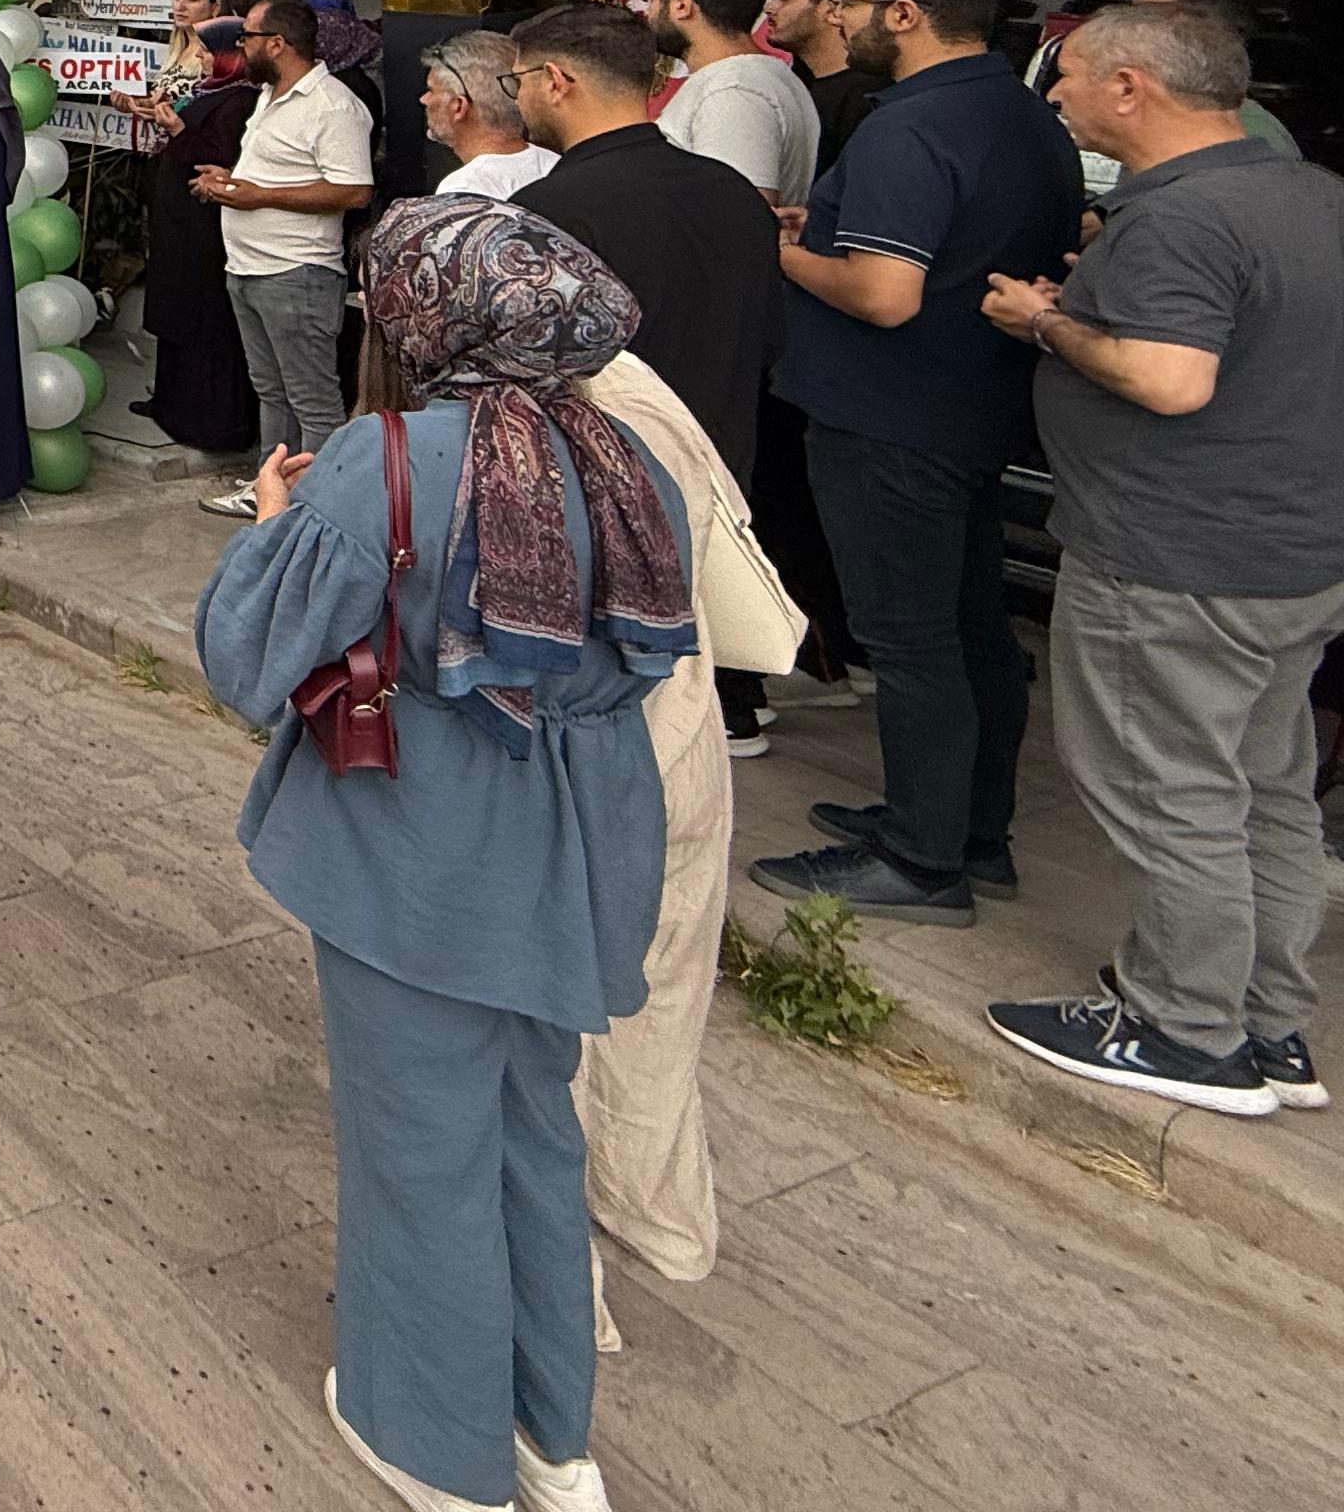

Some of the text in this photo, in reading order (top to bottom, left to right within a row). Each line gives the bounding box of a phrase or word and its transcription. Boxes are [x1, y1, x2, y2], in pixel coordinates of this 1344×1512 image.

[60, 55, 143, 81] OPTİK
[66, 80, 112, 91] ACAR
[46, 108, 98, 131] KHAN
